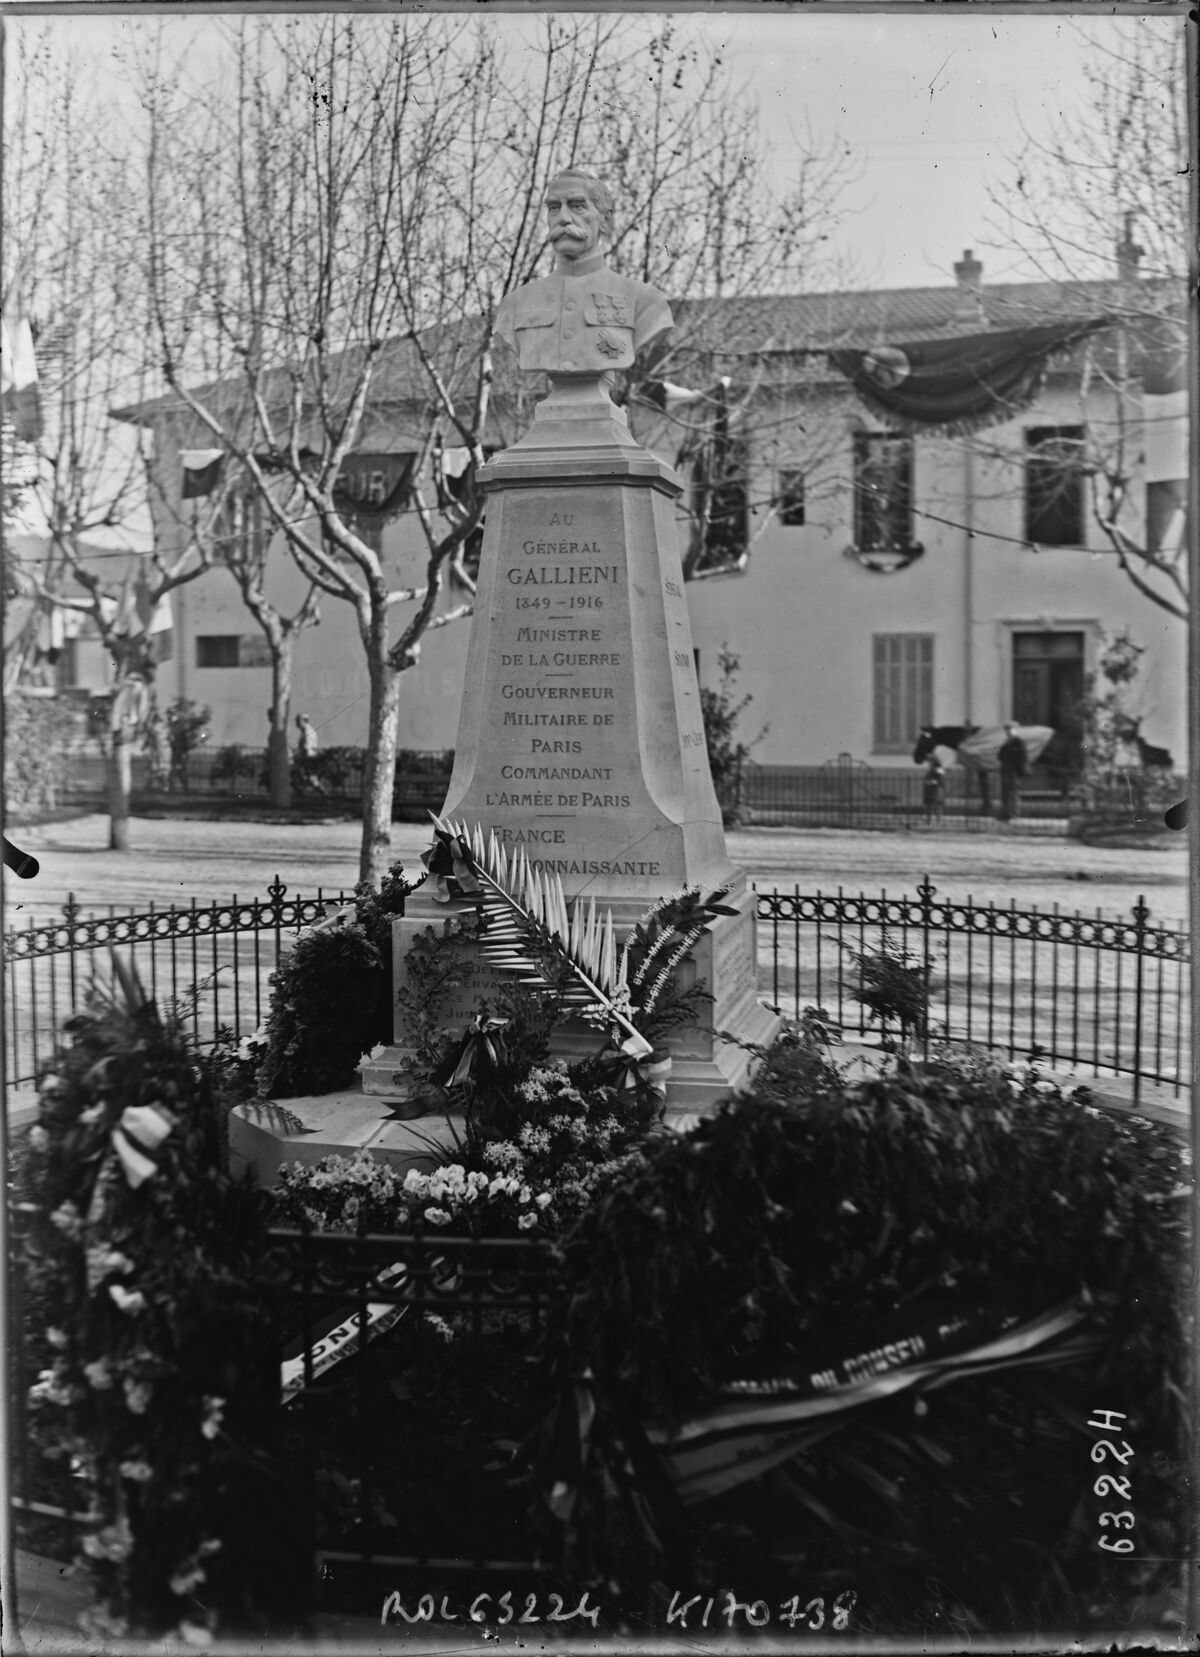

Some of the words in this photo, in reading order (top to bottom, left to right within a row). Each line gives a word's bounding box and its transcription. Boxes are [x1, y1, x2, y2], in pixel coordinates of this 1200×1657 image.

[548, 512, 575, 526] AU
[522, 539, 602, 555] GÉNÉRAL
[507, 566, 619, 585] GALLIENI
[516, 627, 602, 642] MINISTRE
[501, 654, 524, 666] DE
[528, 654, 550, 666] LA
[553, 652, 621, 666] GUERRE
[501, 684, 615, 699] GOUVERNEUR
[503, 711, 588, 726] MILITAIRE
[592, 714, 615, 726] DE
[531, 739, 583, 753] PARIS
[501, 765, 614, 780] COMMANDANT
[558, 794, 579, 807] DE
[581, 792, 631, 808] PARIS
[647, 924, 676, 957] MARNE
